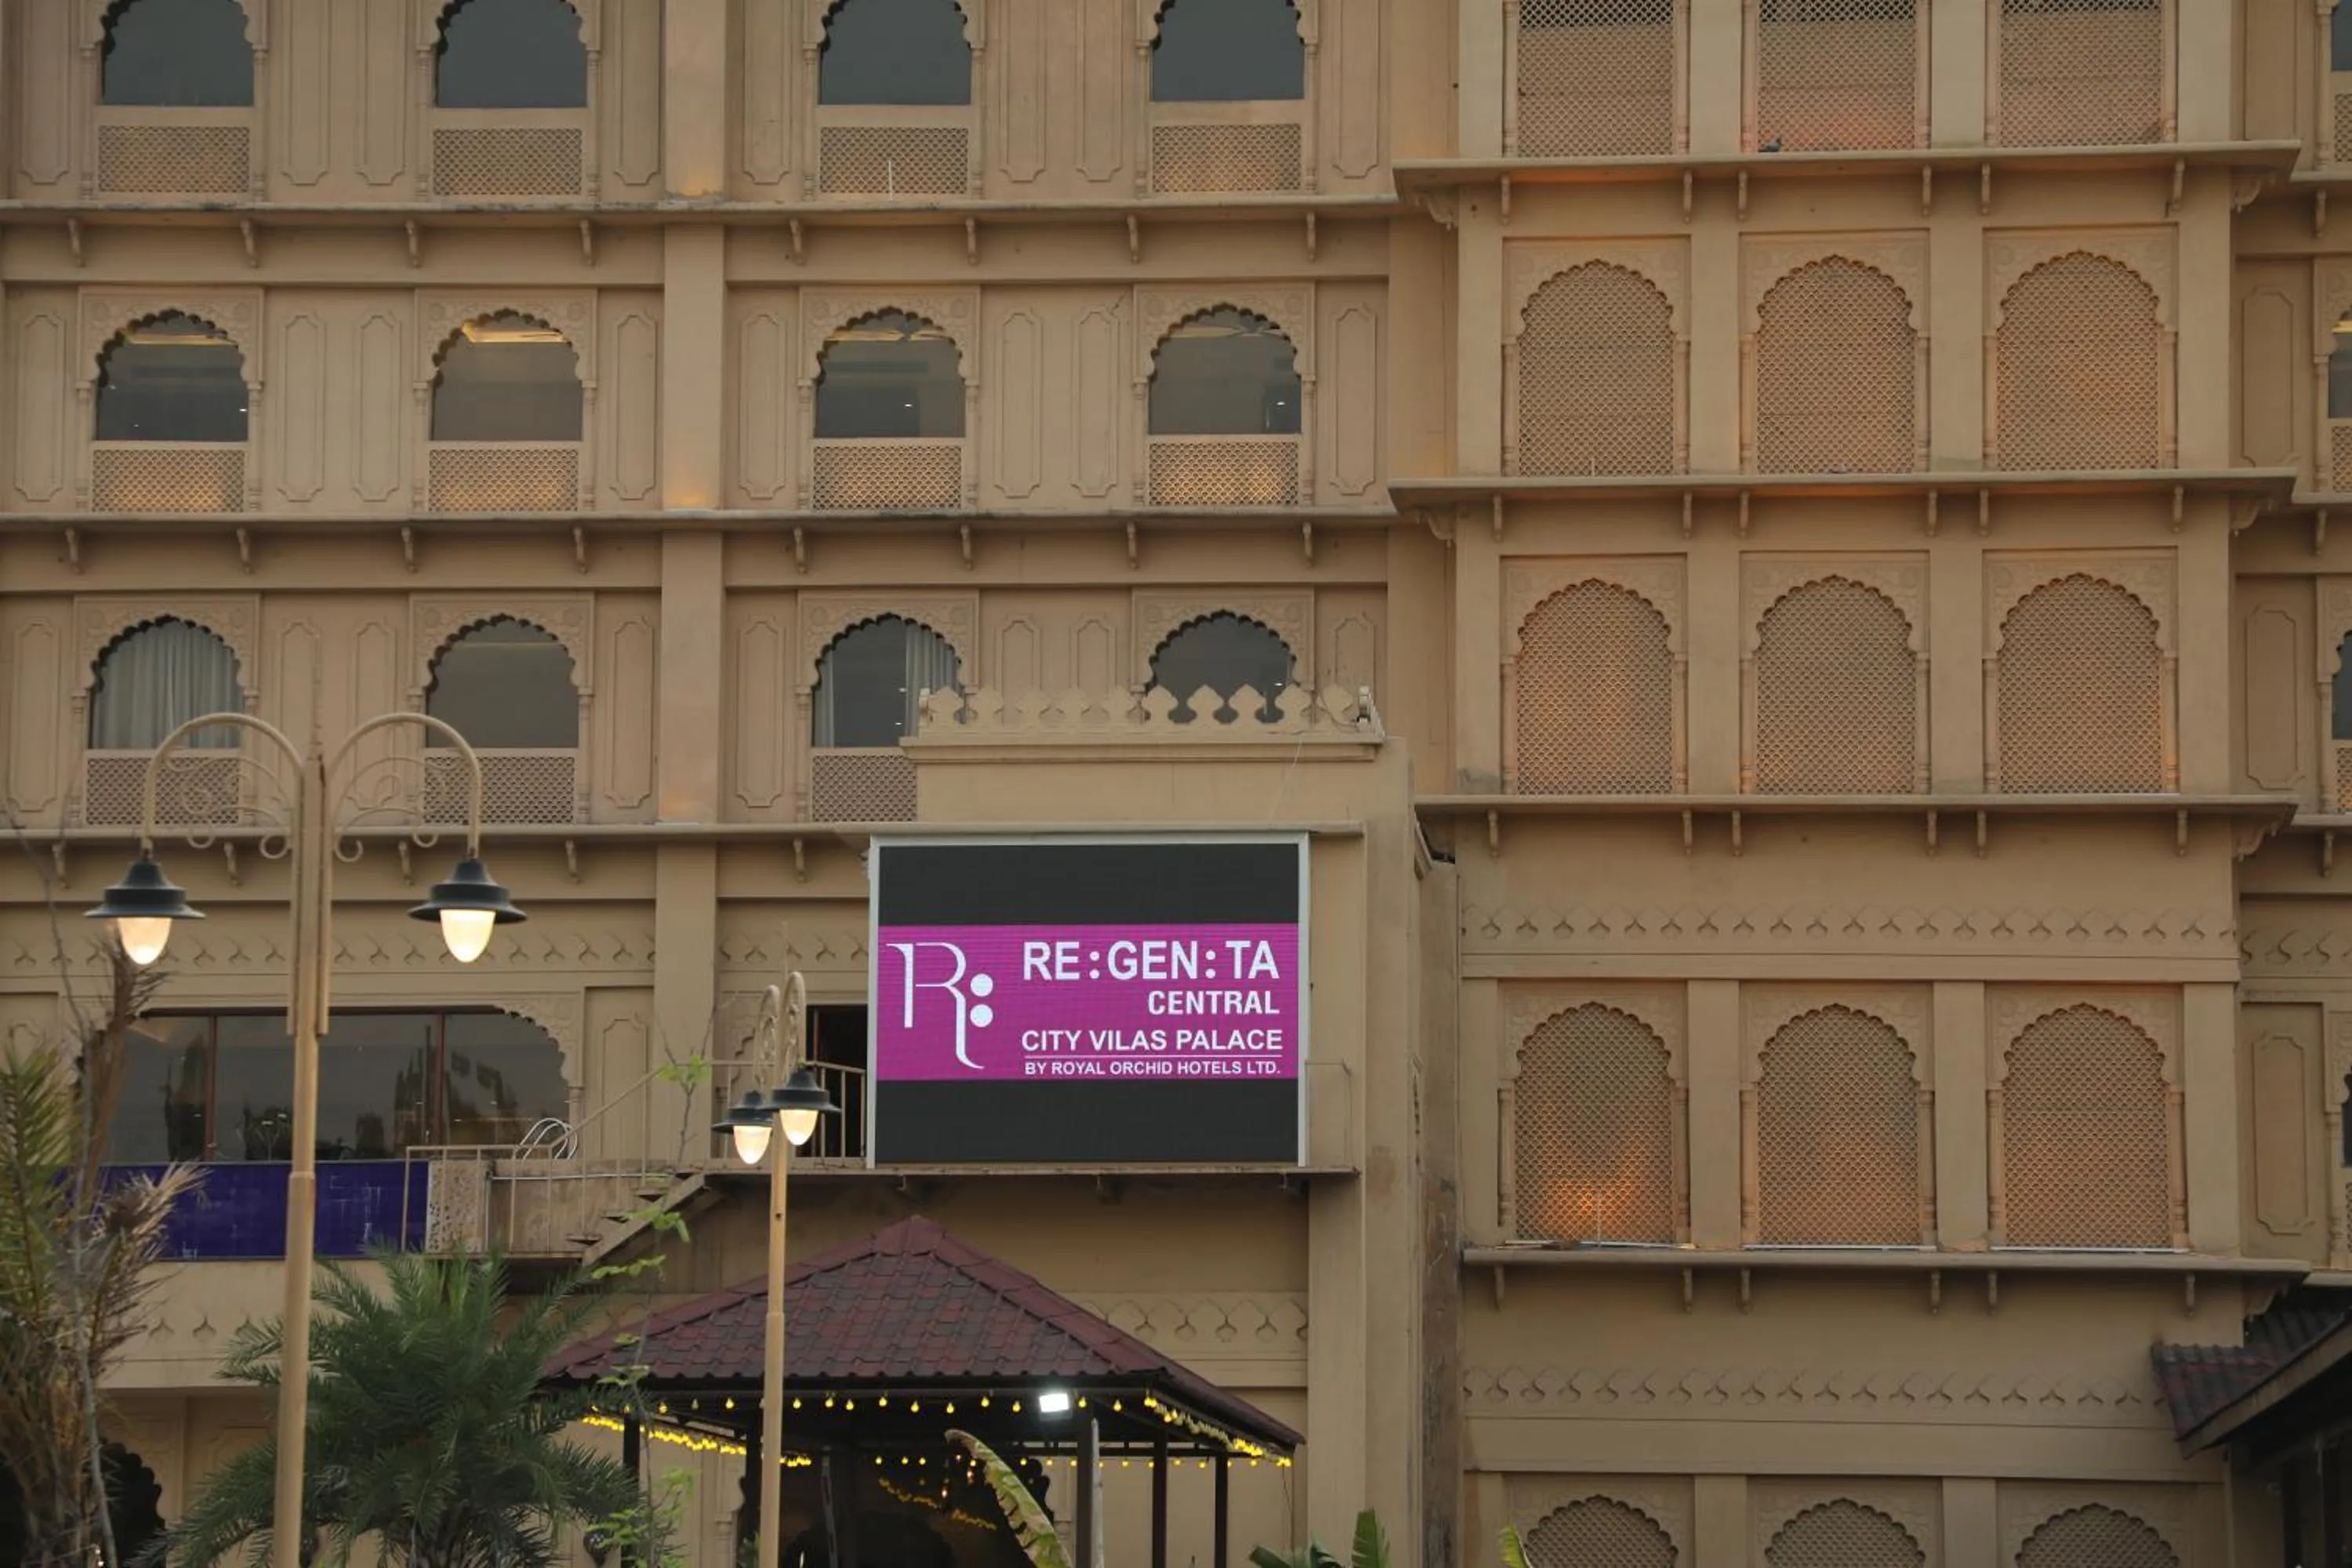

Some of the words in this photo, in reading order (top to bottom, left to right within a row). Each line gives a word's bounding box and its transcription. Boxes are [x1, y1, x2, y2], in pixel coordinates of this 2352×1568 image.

[1148, 991, 1279, 1015] CENTRAL
[1022, 1030, 1082, 1051] CITY
[1089, 1030, 1167, 1051] VILAS
[1177, 1029, 1283, 1051] PALACE
[1025, 1062, 1047, 1075] BY
[1051, 1062, 1105, 1075] ROYAL
[1109, 1061, 1173, 1075] ORCHID
[1178, 1061, 1242, 1074] HOTELS
[1247, 1061, 1280, 1074] LTD.
